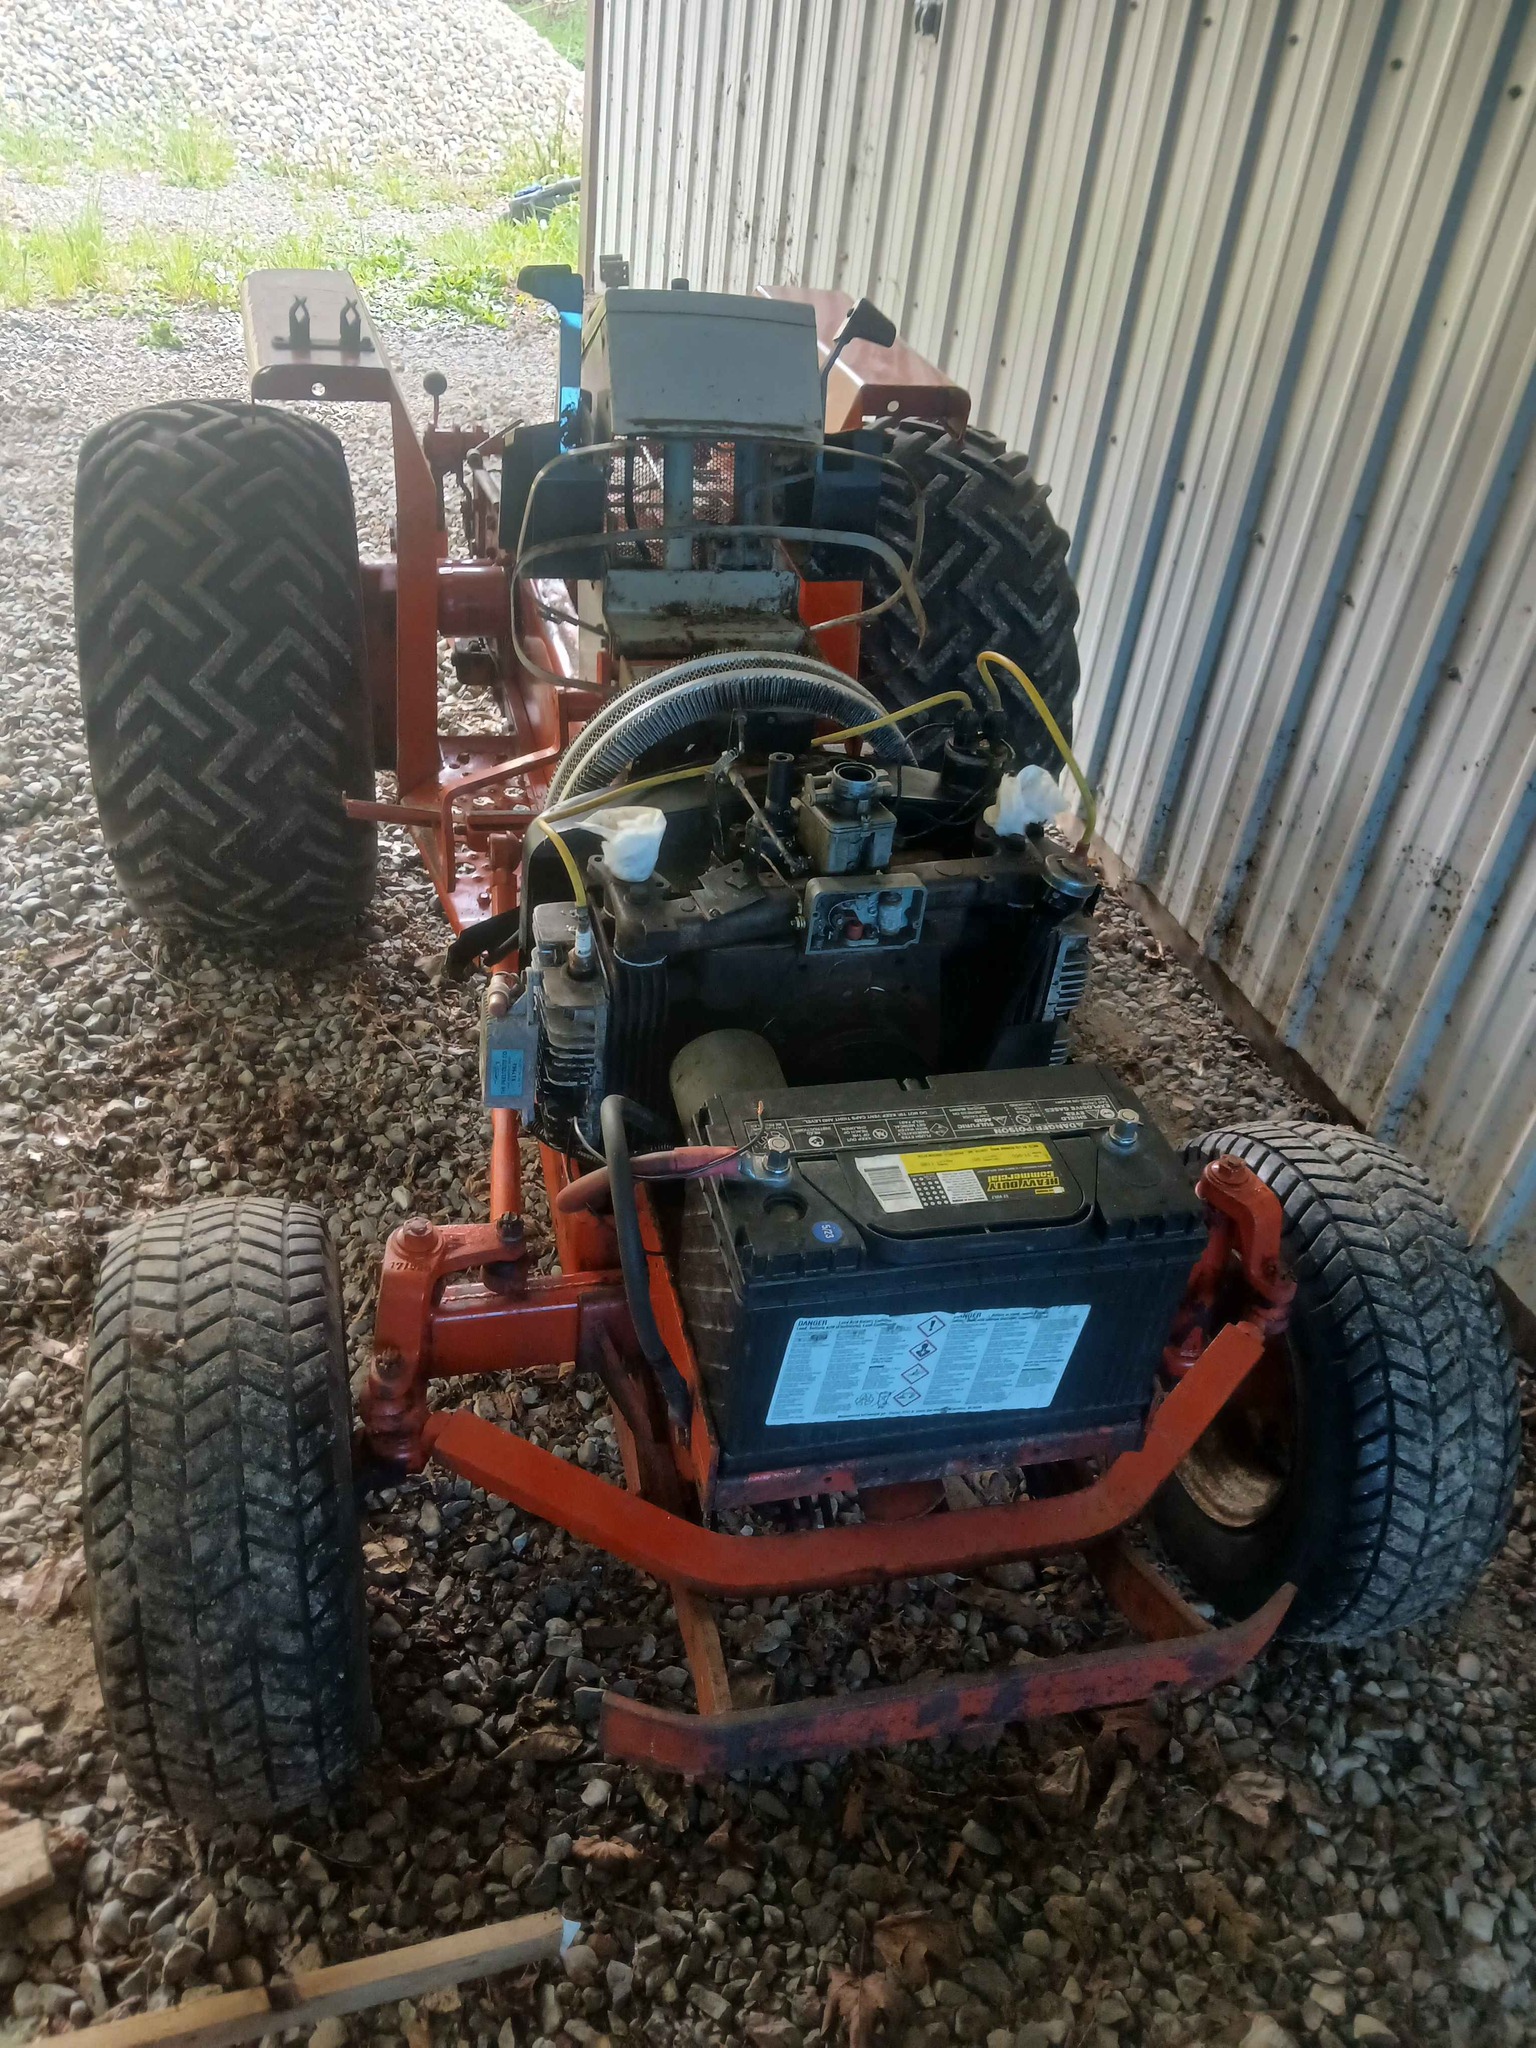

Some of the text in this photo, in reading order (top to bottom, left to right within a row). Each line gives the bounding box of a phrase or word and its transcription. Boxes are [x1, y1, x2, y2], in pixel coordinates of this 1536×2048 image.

[988, 1171, 1054, 1182] Commercial
[987, 1177, 1059, 1191] HEAVY DUTY
[821, 1224, 835, 1239] 5/23
